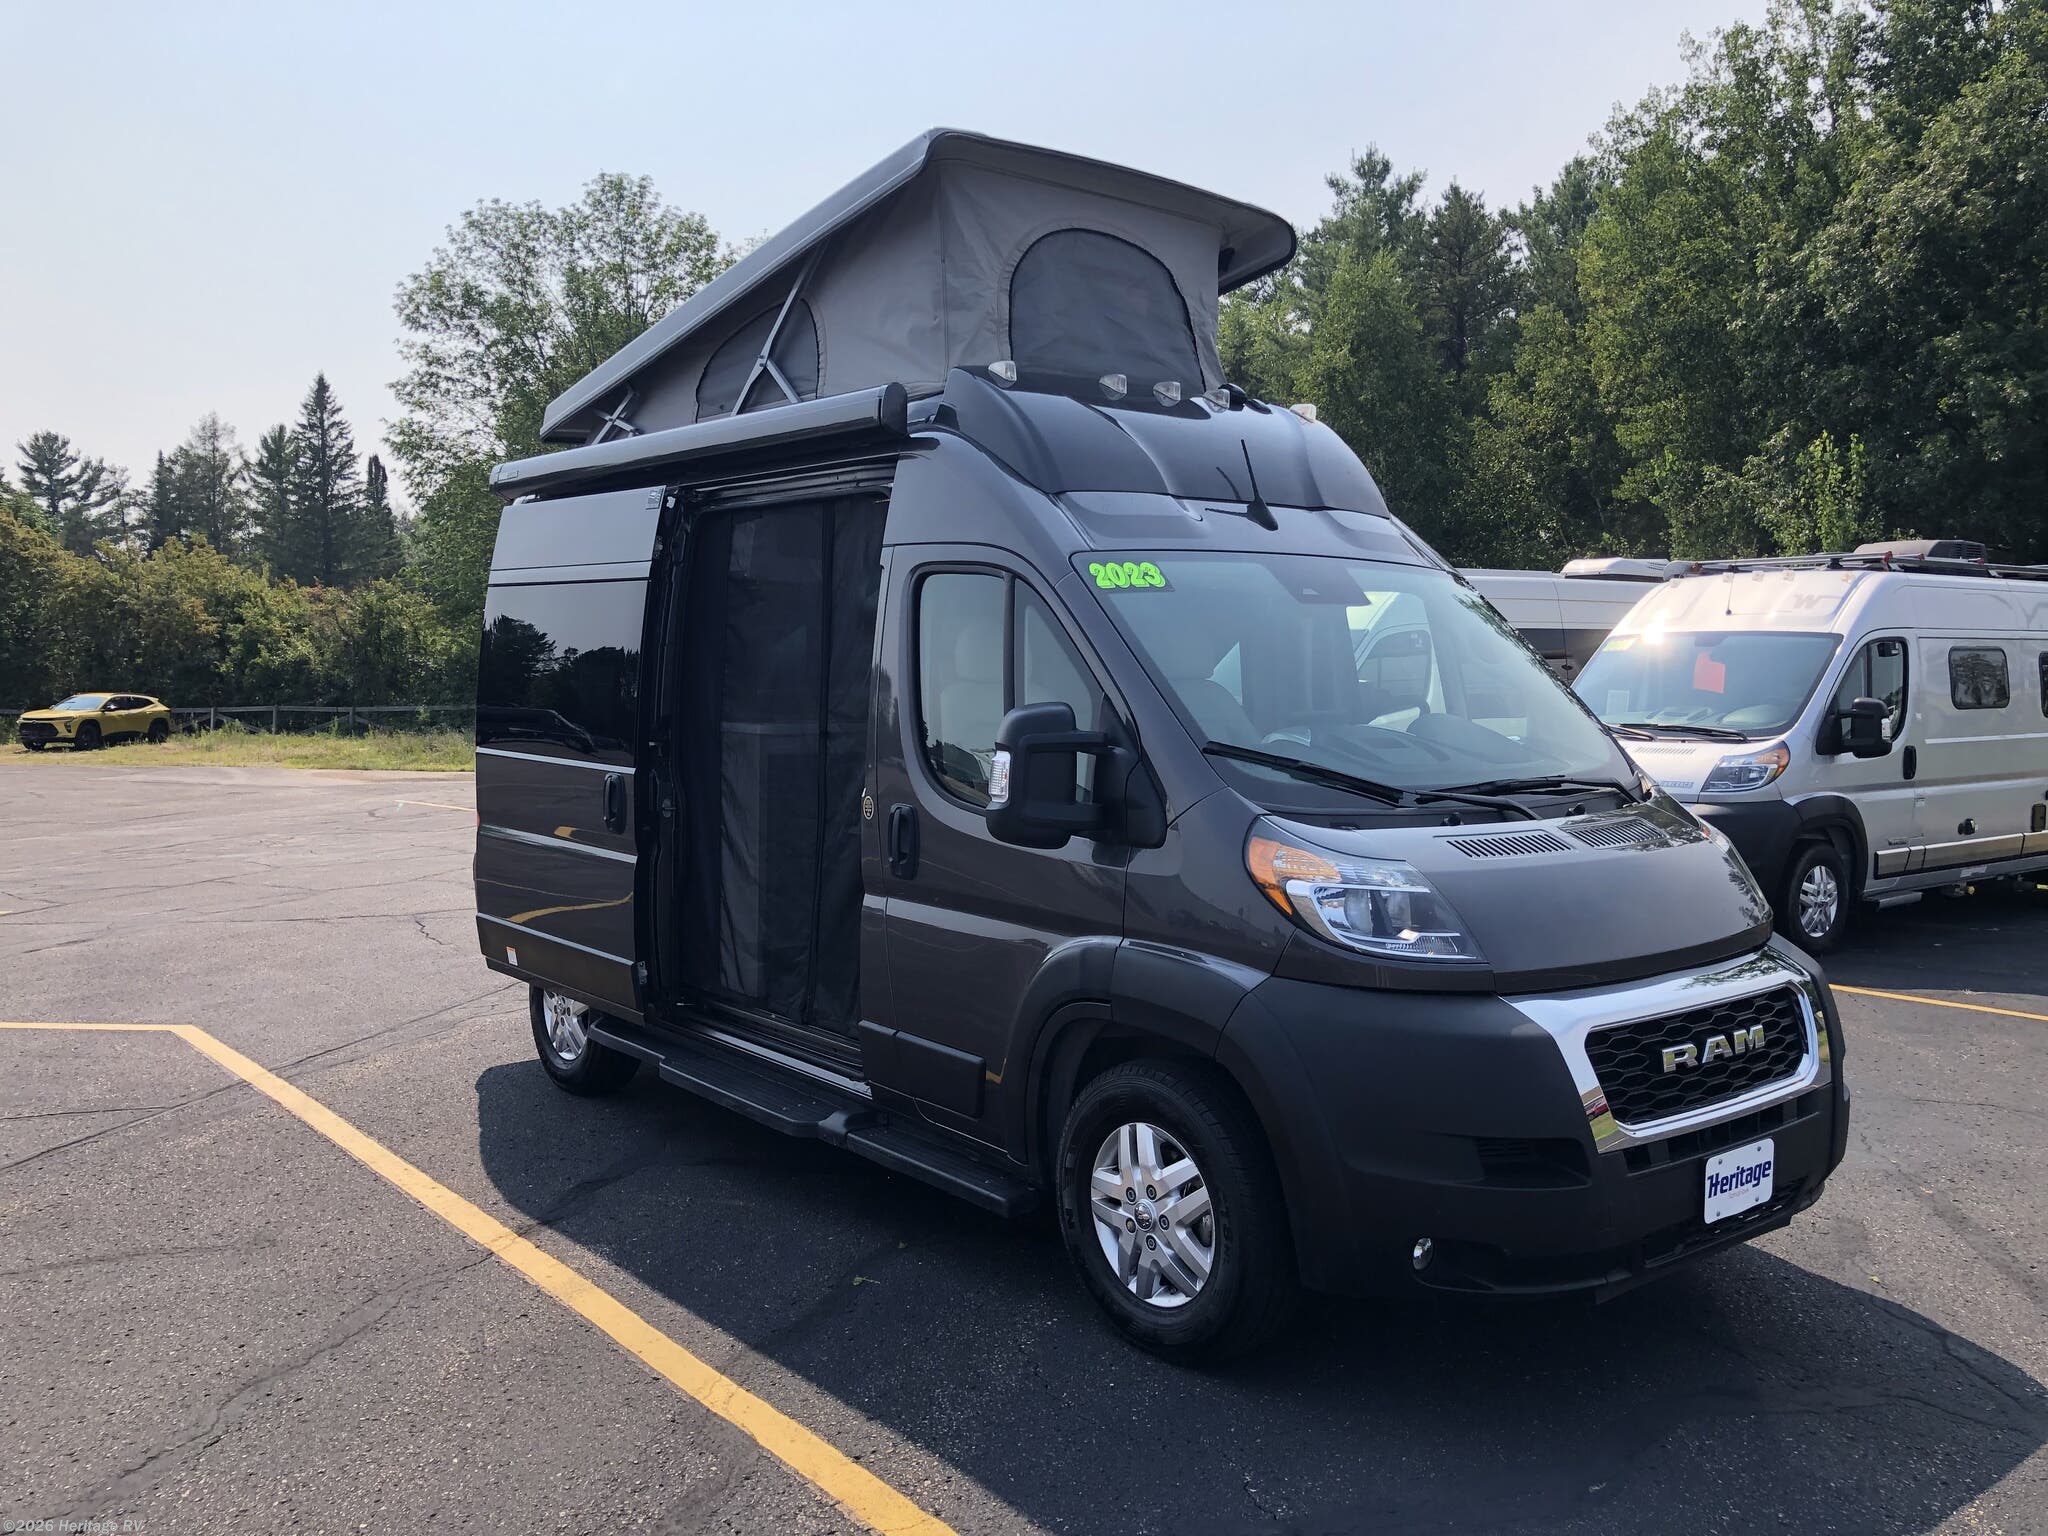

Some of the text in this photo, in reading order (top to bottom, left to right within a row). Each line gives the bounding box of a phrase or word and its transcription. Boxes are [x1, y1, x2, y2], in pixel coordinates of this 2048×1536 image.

[1088, 561, 1166, 589] 2023
[1661, 1023, 1765, 1073] RAM
[1707, 1160, 1772, 1198] Heritage
